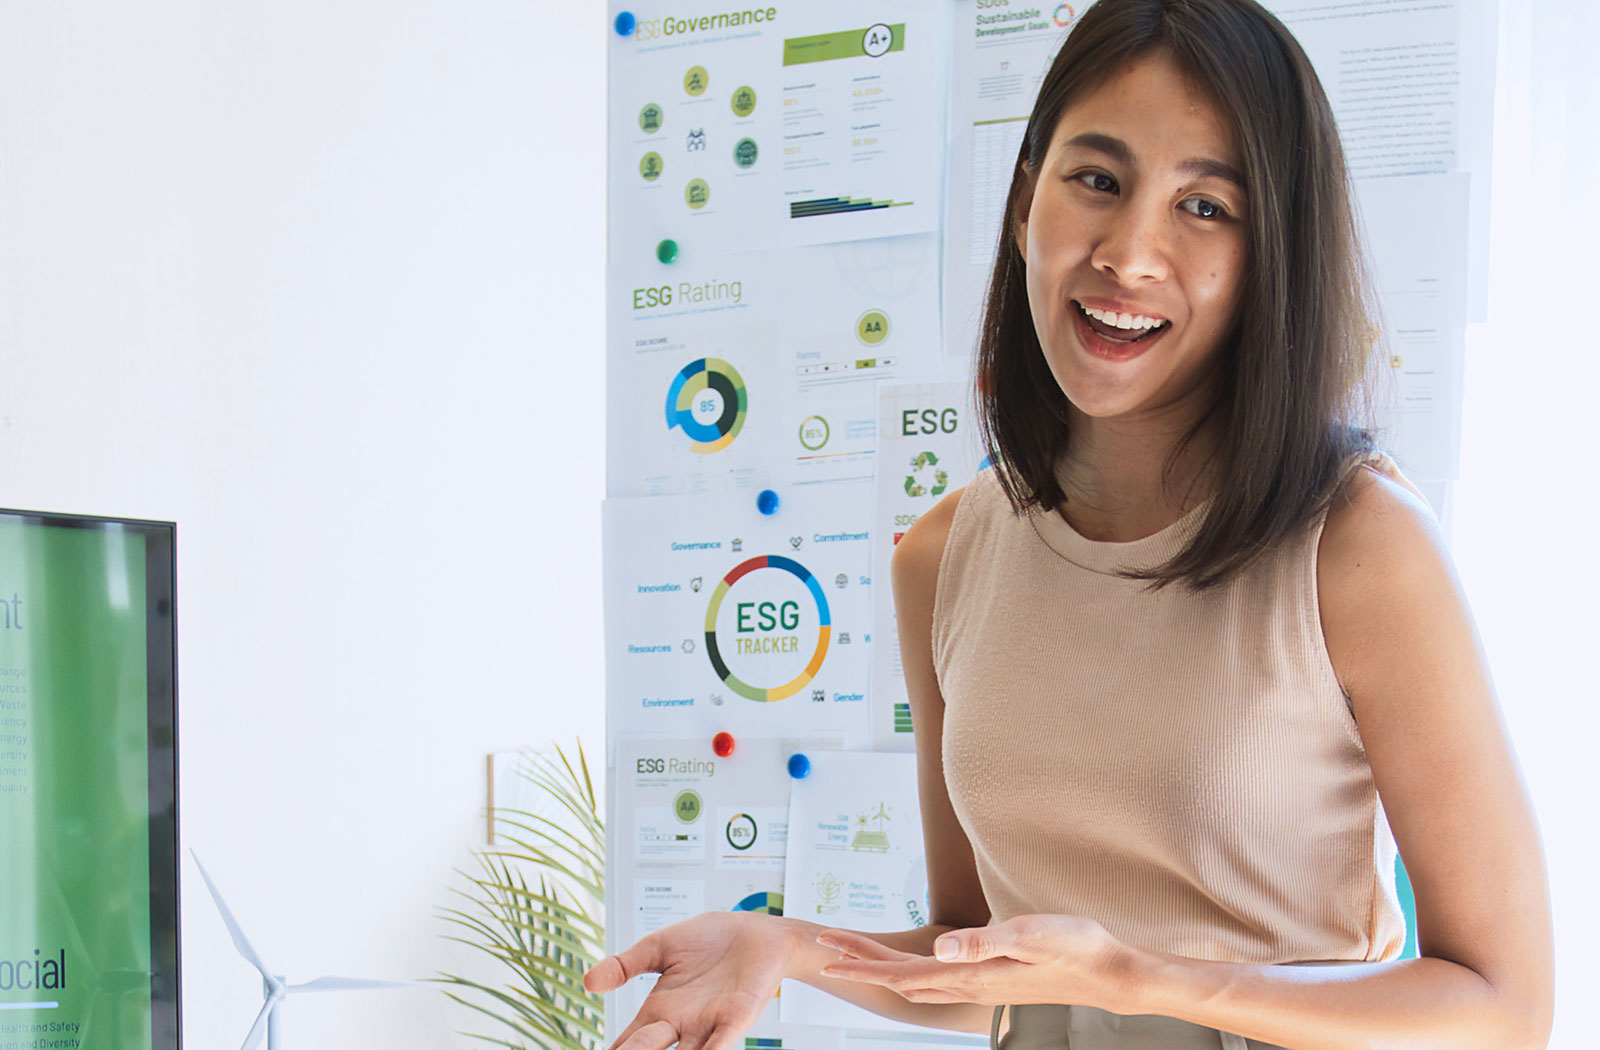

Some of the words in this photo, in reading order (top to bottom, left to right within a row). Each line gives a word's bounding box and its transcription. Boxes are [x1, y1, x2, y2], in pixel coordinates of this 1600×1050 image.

[976, 8, 1041, 25] Sustainable
[636, 19, 662, 41] ESG
[663, 6, 777, 36] Governance
[869, 32, 889, 47] A+
[633, 285, 672, 310] ESG
[678, 279, 742, 304] Rating
[865, 321, 882, 333] AA
[700, 399, 715, 413] 85
[902, 408, 958, 436] ESG
[813, 532, 869, 543] Commitment
[671, 541, 721, 551] Governance
[638, 583, 681, 593] Innovation
[737, 600, 800, 632] ESG
[628, 643, 671, 654] Resources
[736, 636, 799, 655] TRACKER
[642, 697, 694, 707] Environment
[833, 693, 864, 703] Gender
[637, 758, 665, 773] ESG
[669, 758, 715, 777] Rating
[680, 801, 695, 812] AA
[733, 827, 750, 837] 85%
[31, 1022, 48, 1032] and
[49, 1021, 80, 1033] Safety
[20, 1039, 37, 1049] and
[40, 1038, 80, 1049] Diversity
